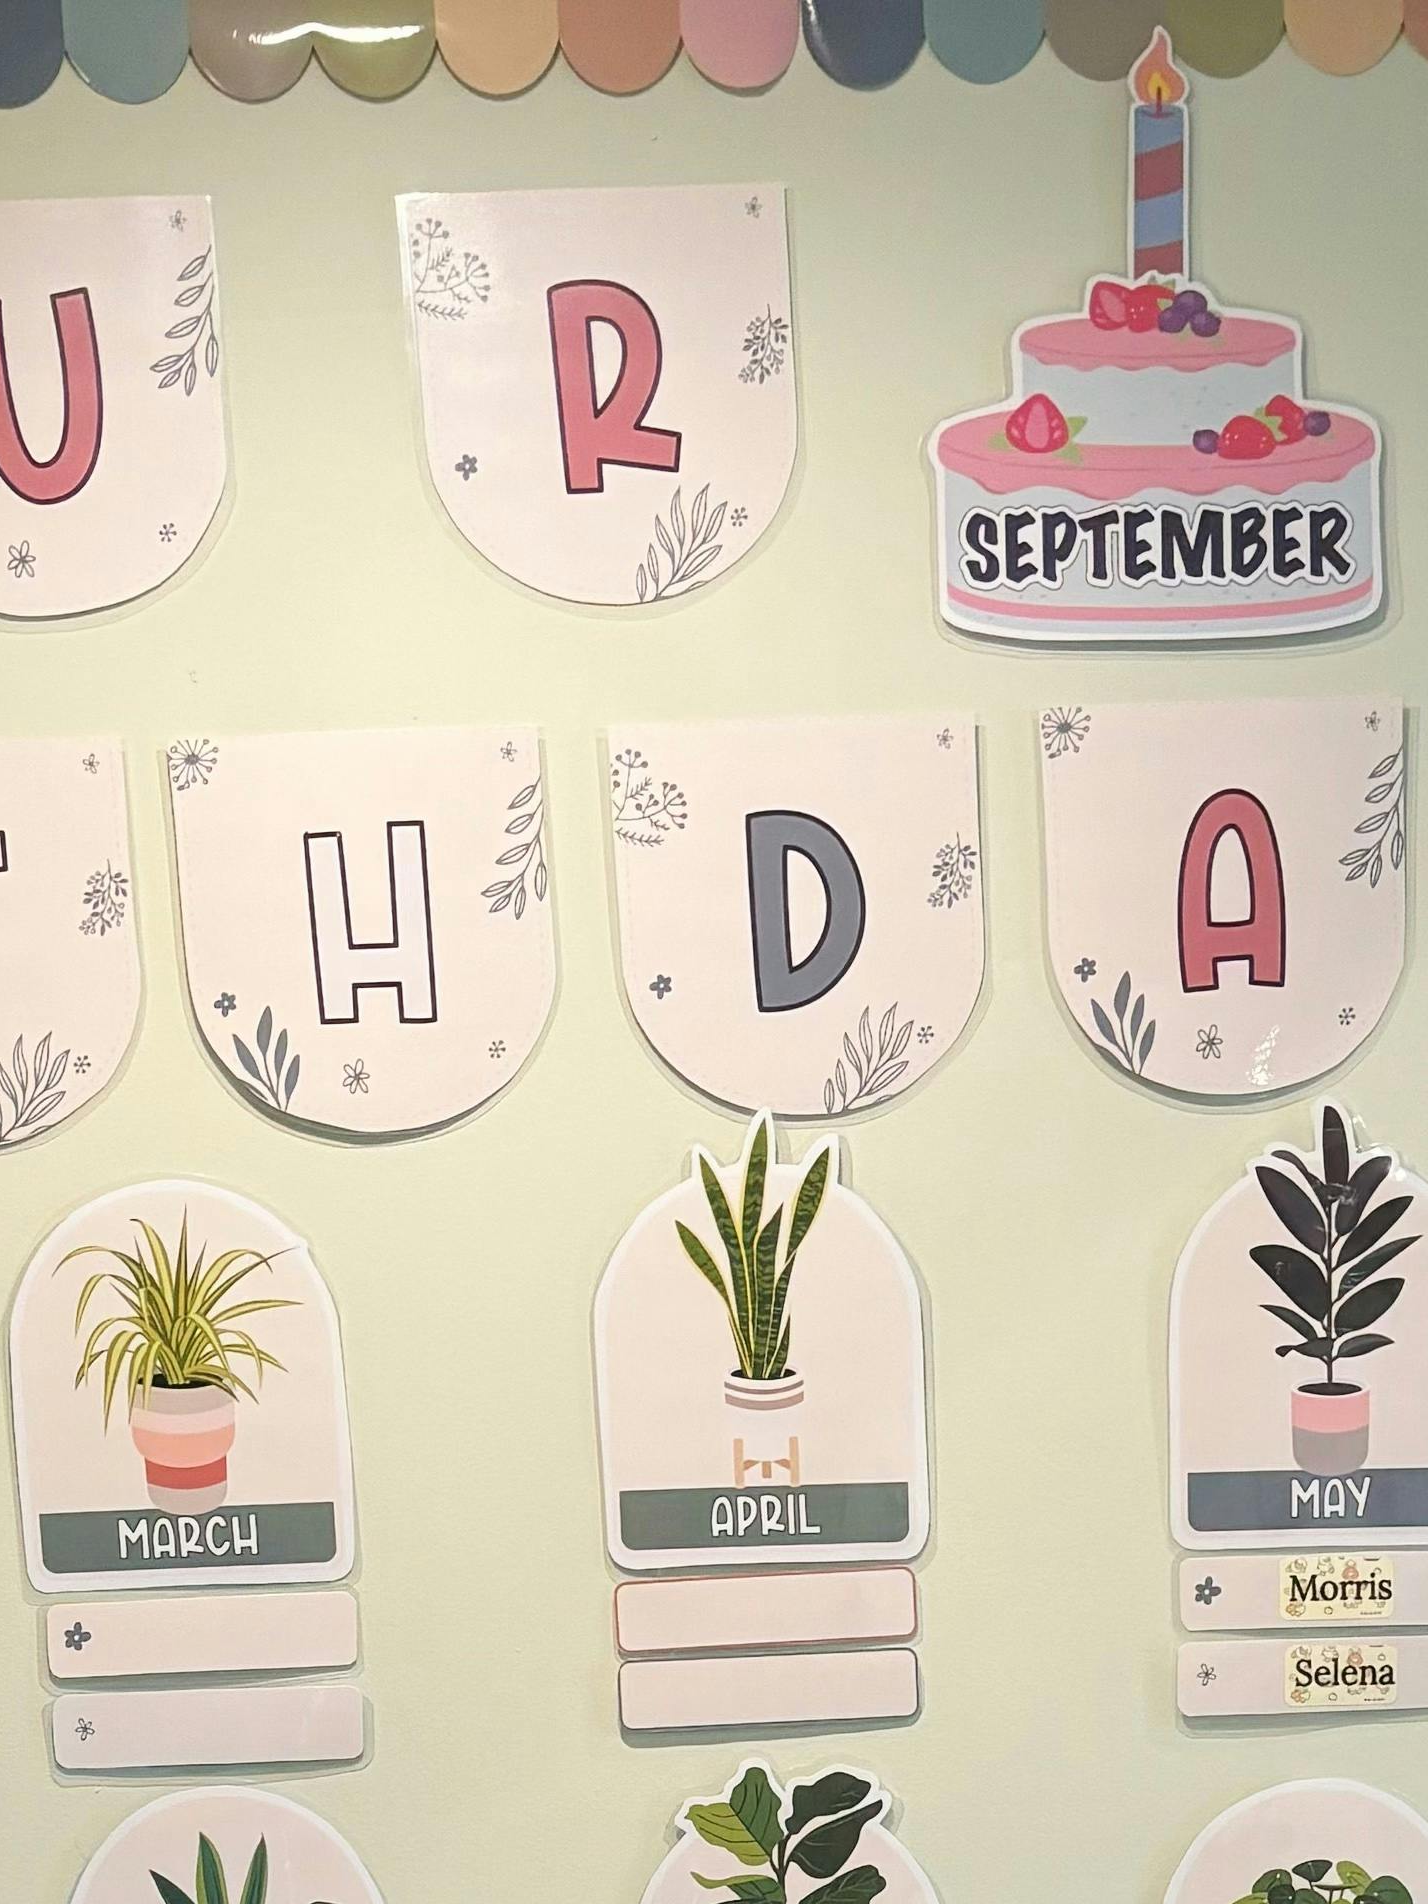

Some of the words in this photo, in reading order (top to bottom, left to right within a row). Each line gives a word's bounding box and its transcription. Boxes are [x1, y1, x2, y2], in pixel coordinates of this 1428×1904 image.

[963, 503, 1351, 587] SEPTEMBER
[711, 1493, 821, 1537] APRIL
[1290, 1476, 1371, 1518] MAY
[117, 1514, 259, 1560] MARCH
[1289, 1571, 1393, 1602] Morris
[1295, 1657, 1396, 1688] Selena
